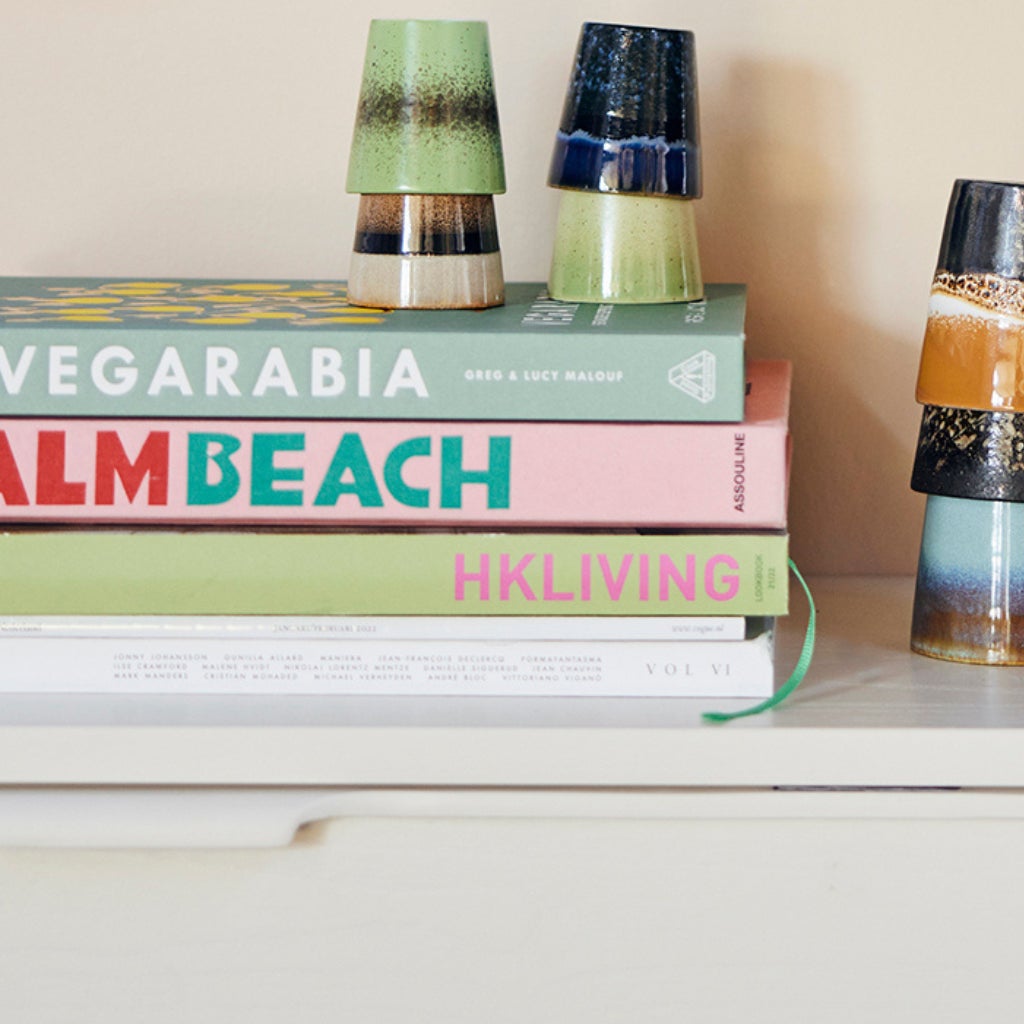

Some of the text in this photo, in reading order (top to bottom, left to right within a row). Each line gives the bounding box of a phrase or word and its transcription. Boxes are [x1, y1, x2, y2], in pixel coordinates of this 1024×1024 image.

[0, 345, 430, 398] VEGARABIA
[464, 369, 624, 382] GREG & LUCY MALOUF
[186, 432, 512, 510] BEACH
[733, 432, 746, 513] ASSOULINE
[454, 553, 740, 602] HKLIVING
[755, 554, 764, 603] LOOKBOOK
[646, 663, 731, 677] VOL VI
